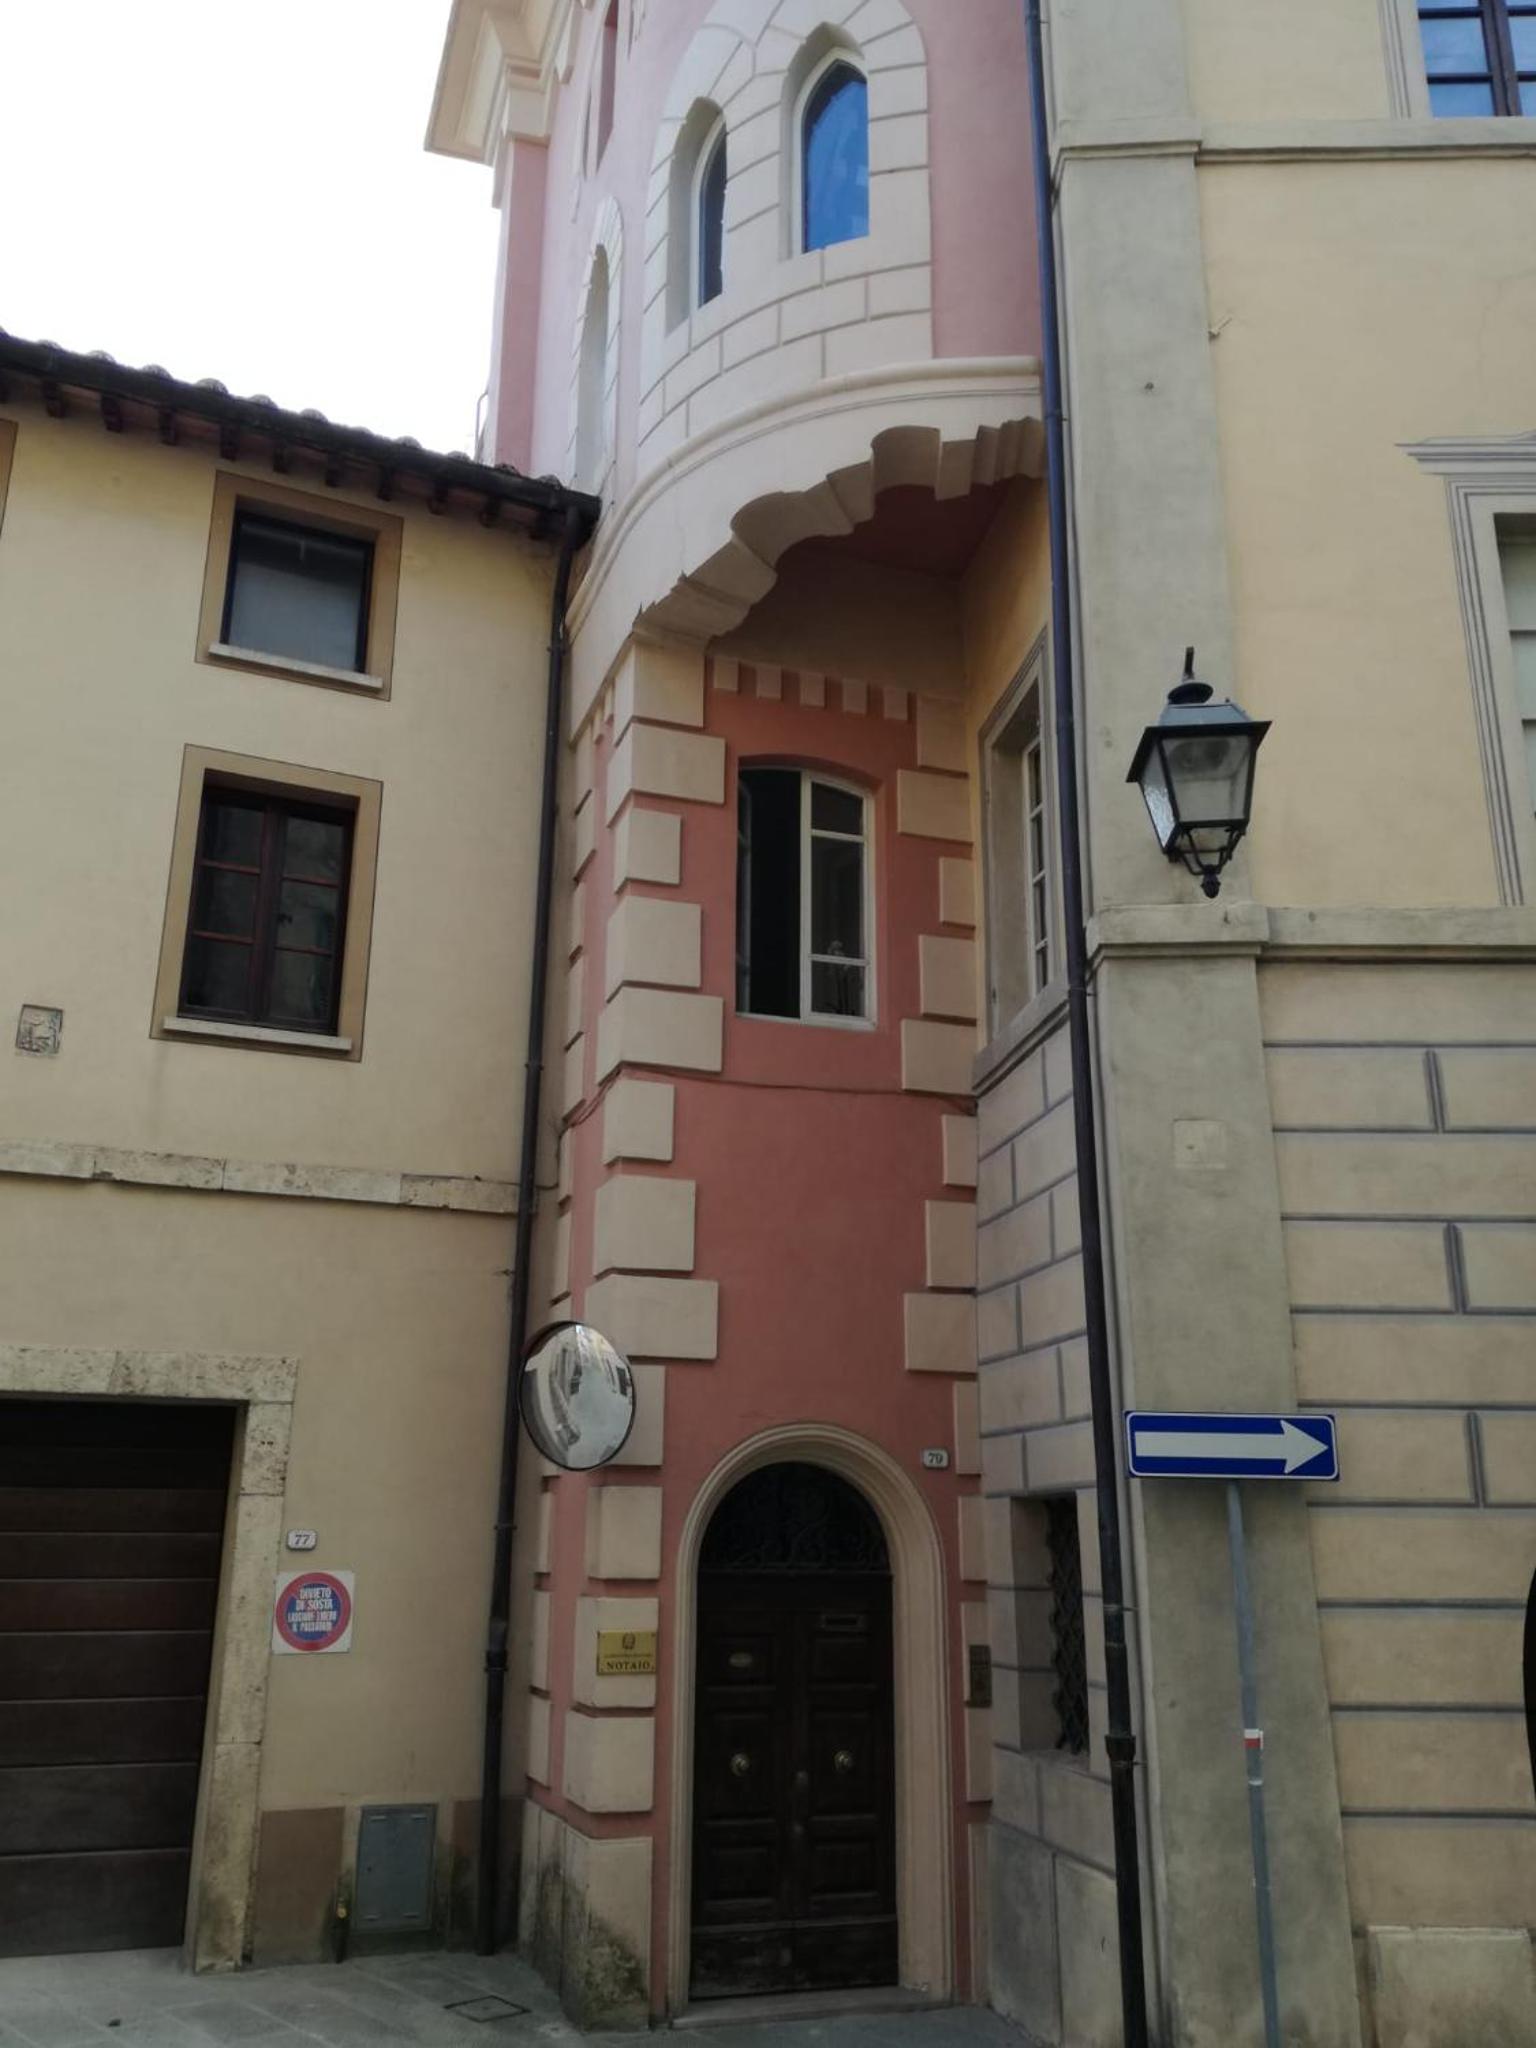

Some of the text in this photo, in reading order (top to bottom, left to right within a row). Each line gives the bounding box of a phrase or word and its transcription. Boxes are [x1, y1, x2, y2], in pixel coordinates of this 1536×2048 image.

[295, 1534, 310, 1545] 77
[300, 1587, 332, 1599] DIVIETO
[296, 1598, 333, 1611] DI SOSTA
[606, 1660, 650, 1670] NOTAIO
